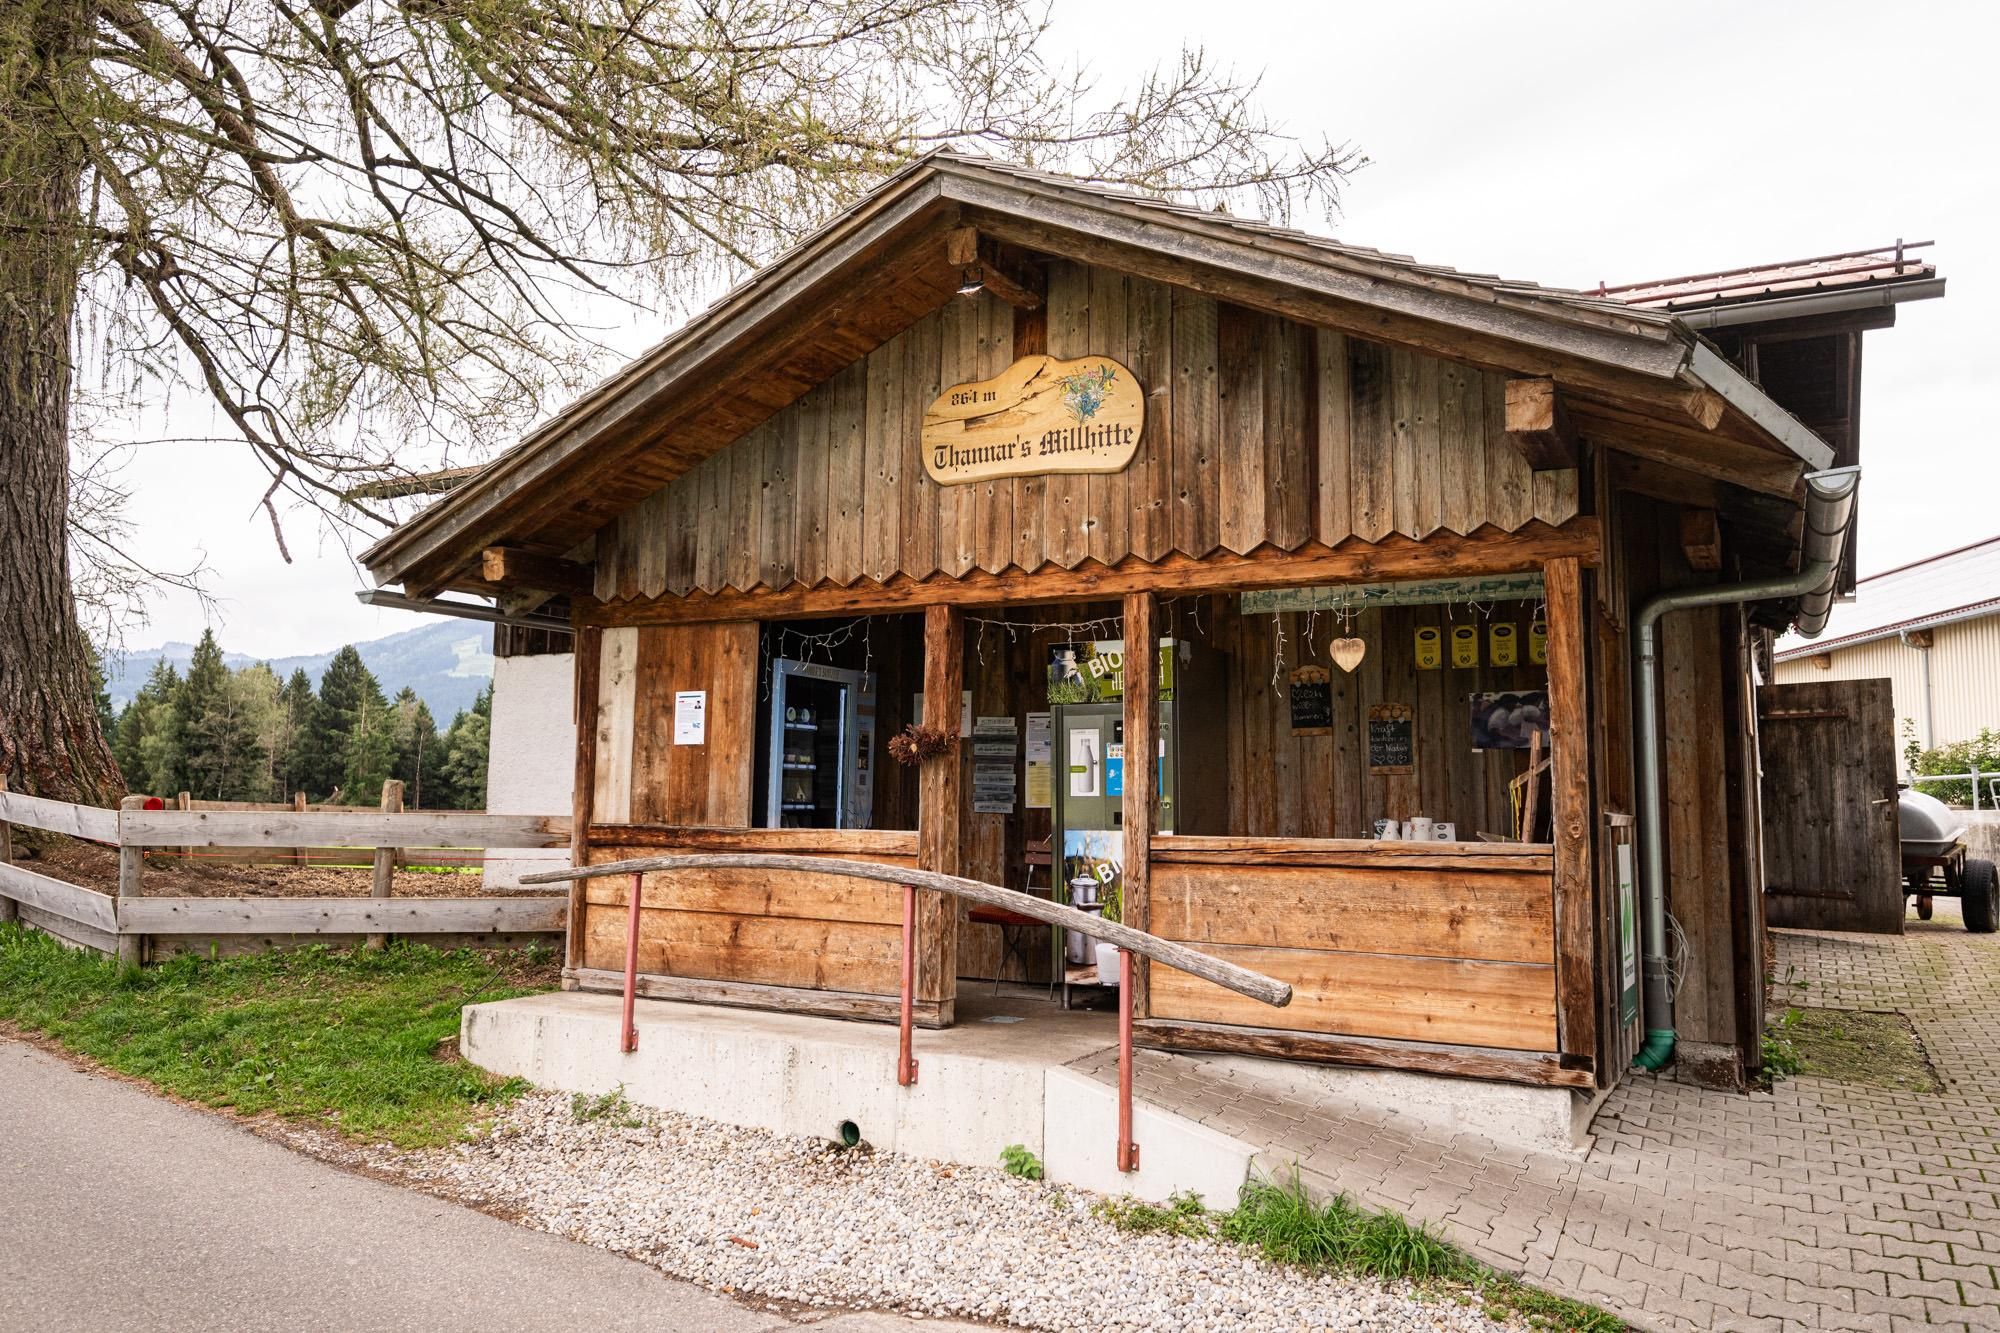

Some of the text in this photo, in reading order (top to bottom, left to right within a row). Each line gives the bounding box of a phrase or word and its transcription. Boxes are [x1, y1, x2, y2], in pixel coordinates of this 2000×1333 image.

[951, 390, 978, 406] 864
[934, 423, 1134, 472] Thannar's Millhitte
